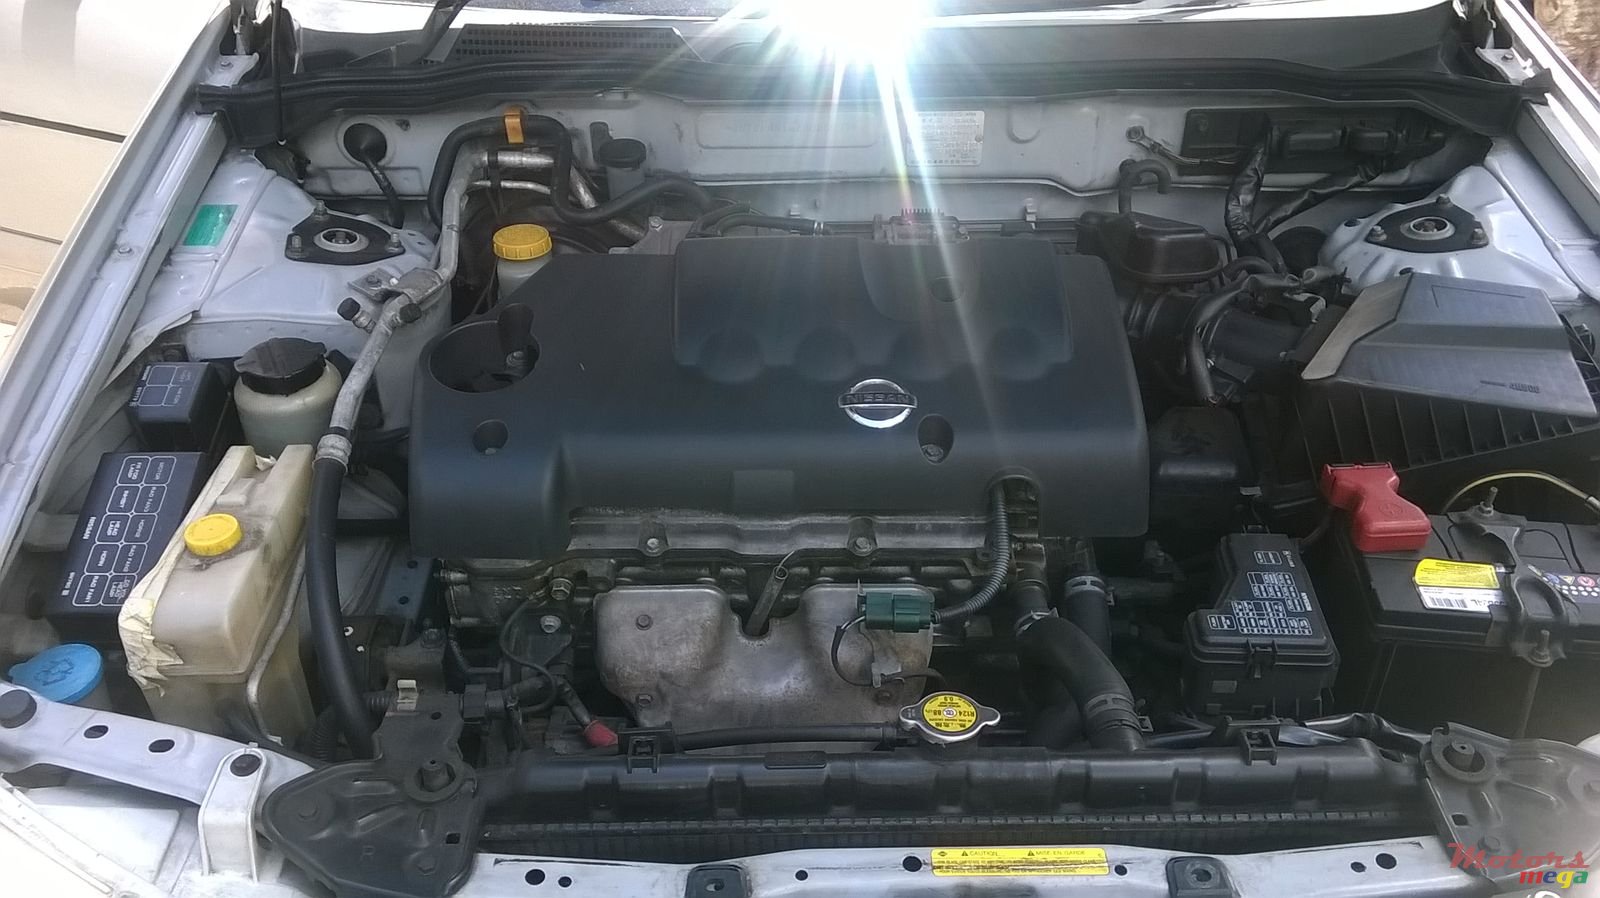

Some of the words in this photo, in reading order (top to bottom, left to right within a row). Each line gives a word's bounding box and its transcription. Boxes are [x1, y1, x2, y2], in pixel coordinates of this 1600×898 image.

[846, 393, 910, 403] NISSAN
[82, 516, 97, 540] NISSAN
[97, 550, 107, 567] HORN
